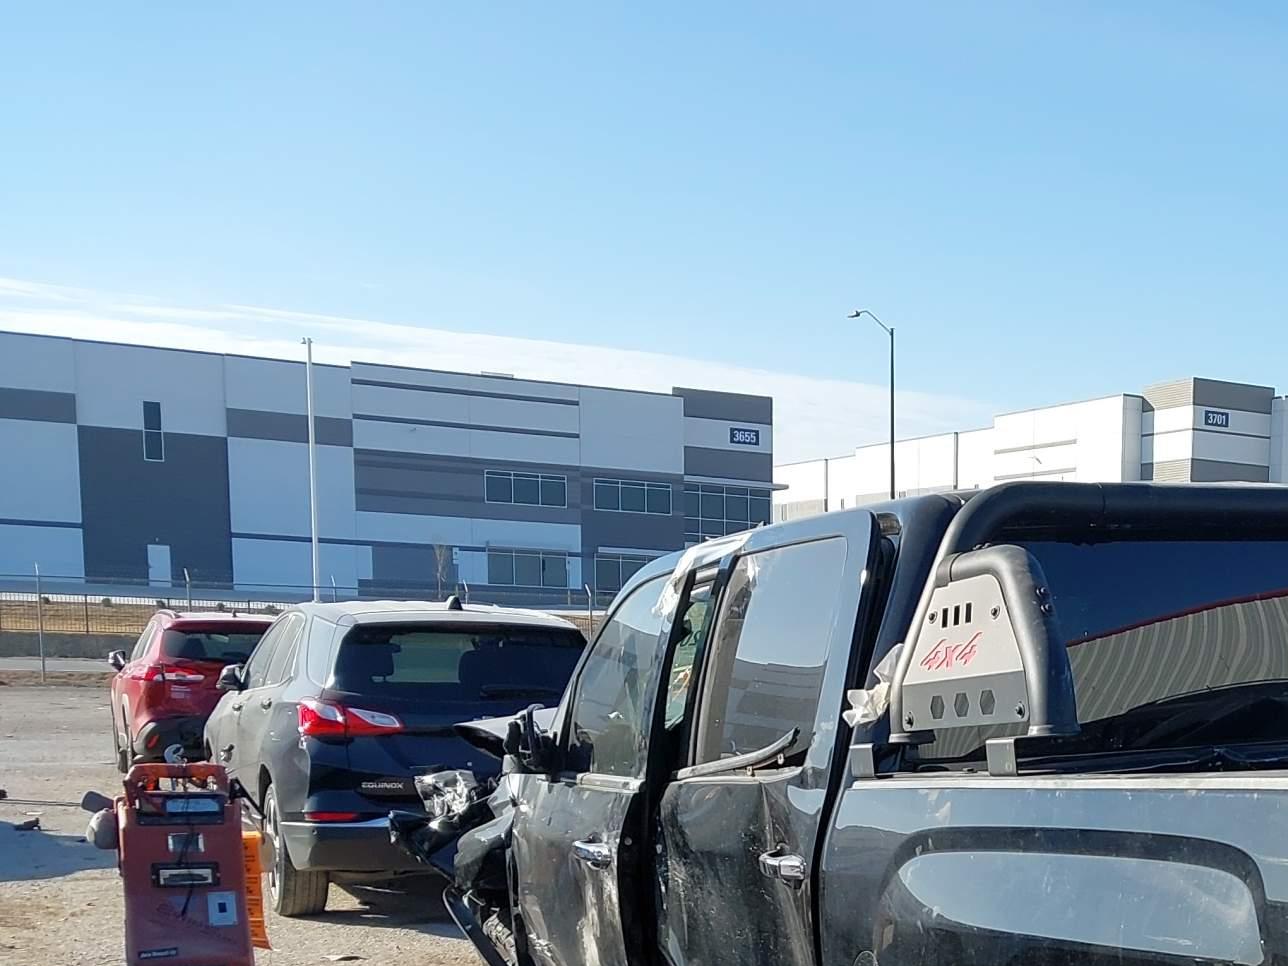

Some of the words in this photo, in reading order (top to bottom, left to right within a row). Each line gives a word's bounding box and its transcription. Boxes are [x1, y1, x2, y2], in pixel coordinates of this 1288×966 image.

[1208, 413, 1226, 425] 3701
[733, 430, 756, 443] 3655
[361, 781, 404, 790] EQUINOX
